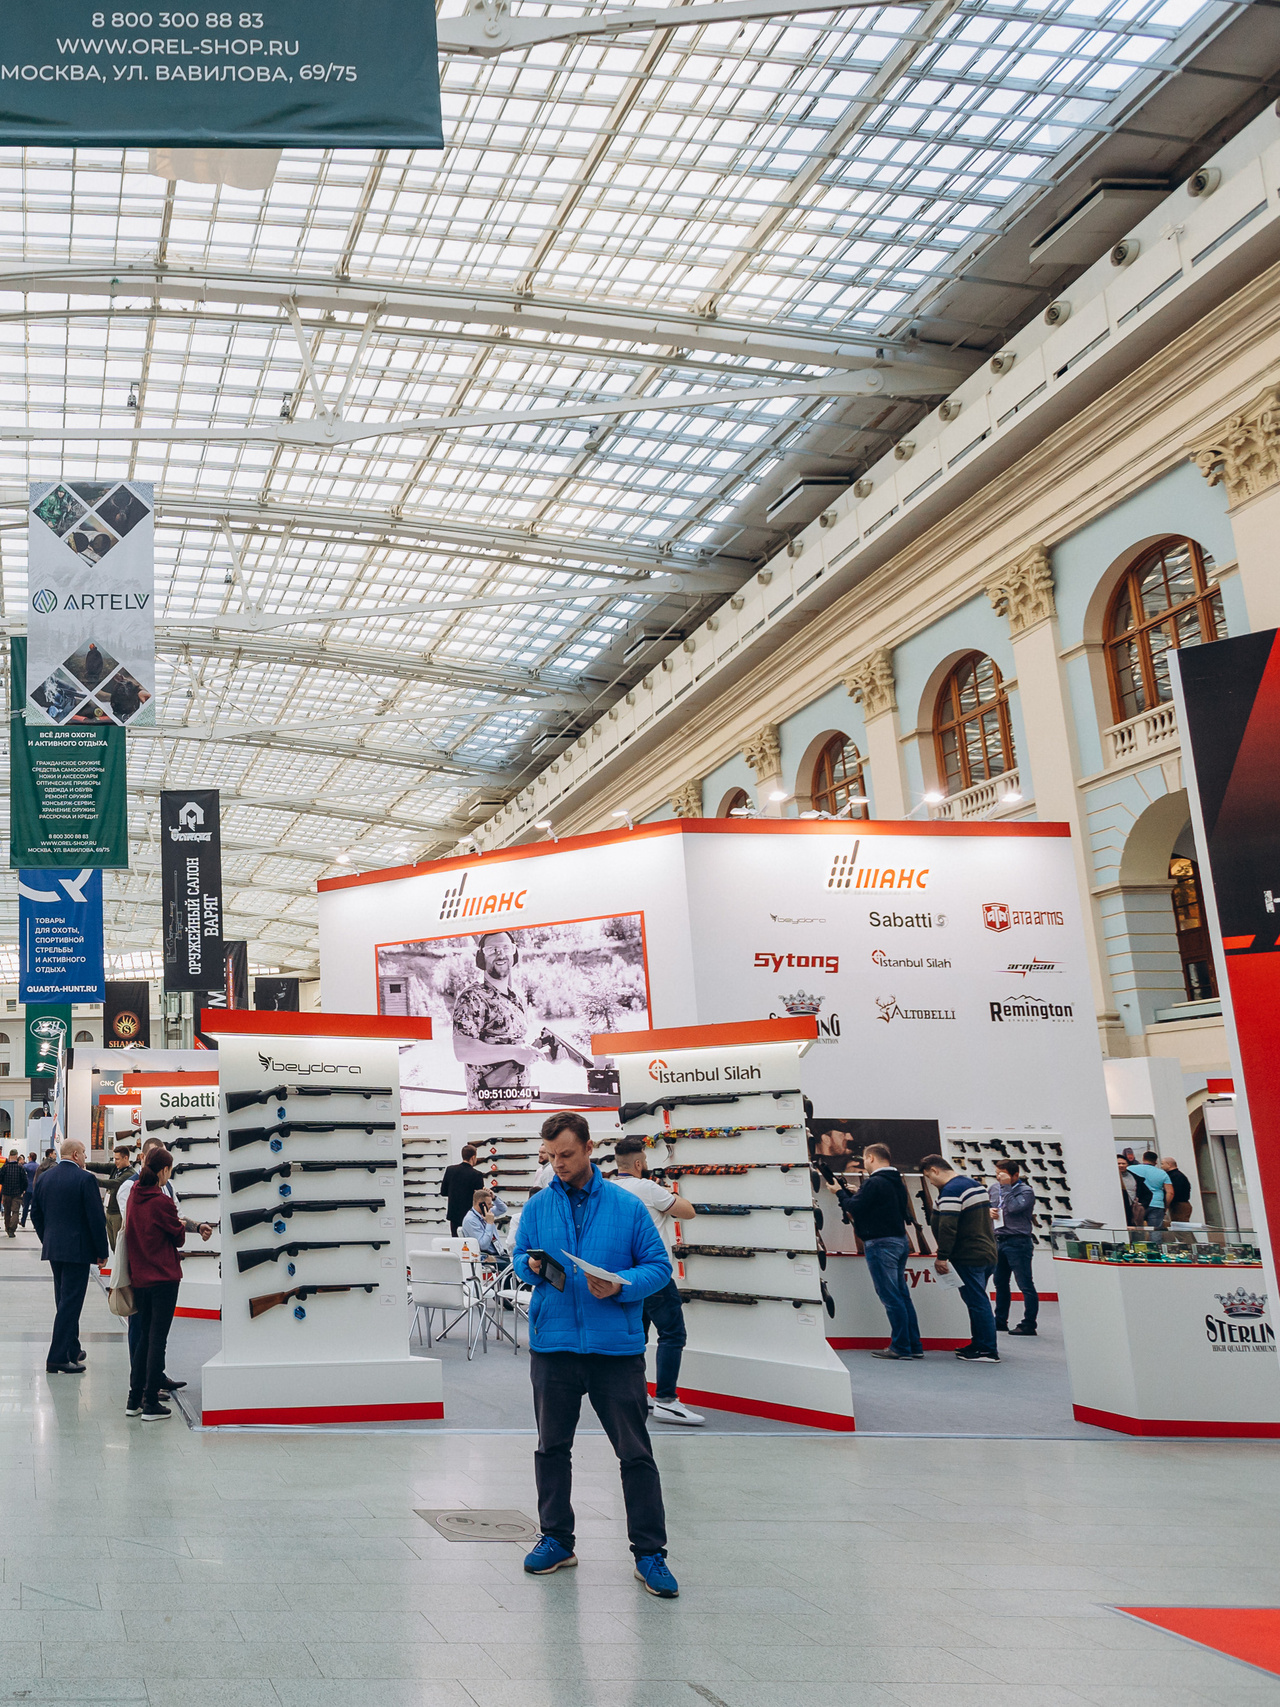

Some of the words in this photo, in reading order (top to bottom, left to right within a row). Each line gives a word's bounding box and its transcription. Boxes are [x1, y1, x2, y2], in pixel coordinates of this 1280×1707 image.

[92, 12, 106, 28] 8
[111, 12, 153, 28] 800
[158, 12, 199, 29] 300
[205, 13, 233, 29] 88
[237, 13, 265, 29] 83
[56, 37, 300, 57] WWW.OREL-SHOP.RU
[1, 64, 106, 83] МОСКВА,
[112, 64, 149, 82] УЛ.
[155, 65, 294, 84] ВАВИЛОВА,
[299, 63, 357, 83] 69/75
[186, 857, 200, 896] САЛОН
[855, 868, 930, 890] ШАНС
[461, 889, 529, 917] ШАНС
[203, 893, 219, 937] ВАРЯГ
[869, 911, 933, 928] Sabatti
[51, 927, 80, 935] ОХОТЫ,
[184, 898, 201, 975] ОРУЖЕЙНЫЙ
[35, 966, 67, 974] ОТДЫХА
[753, 952, 840, 974] Sytong
[879, 957, 924, 969] Istanbul
[926, 957, 952, 969] Silah
[1007, 963, 1055, 973] armsan
[26, 985, 98, 993] QUARTA-HUNT.RU
[890, 1004, 956, 1020] ALTOBELLI
[989, 1001, 1074, 1022] Remington
[271, 1060, 362, 1076] beydora
[659, 1067, 720, 1084] Istanbul
[723, 1065, 762, 1081] Silah
[159, 1092, 215, 1108] Sabatti
[478, 1088, 532, 1100] 09:51:00:40
[1212, 1344, 1227, 1352] HIGH
[1227, 1344, 1251, 1353] QUALITY
